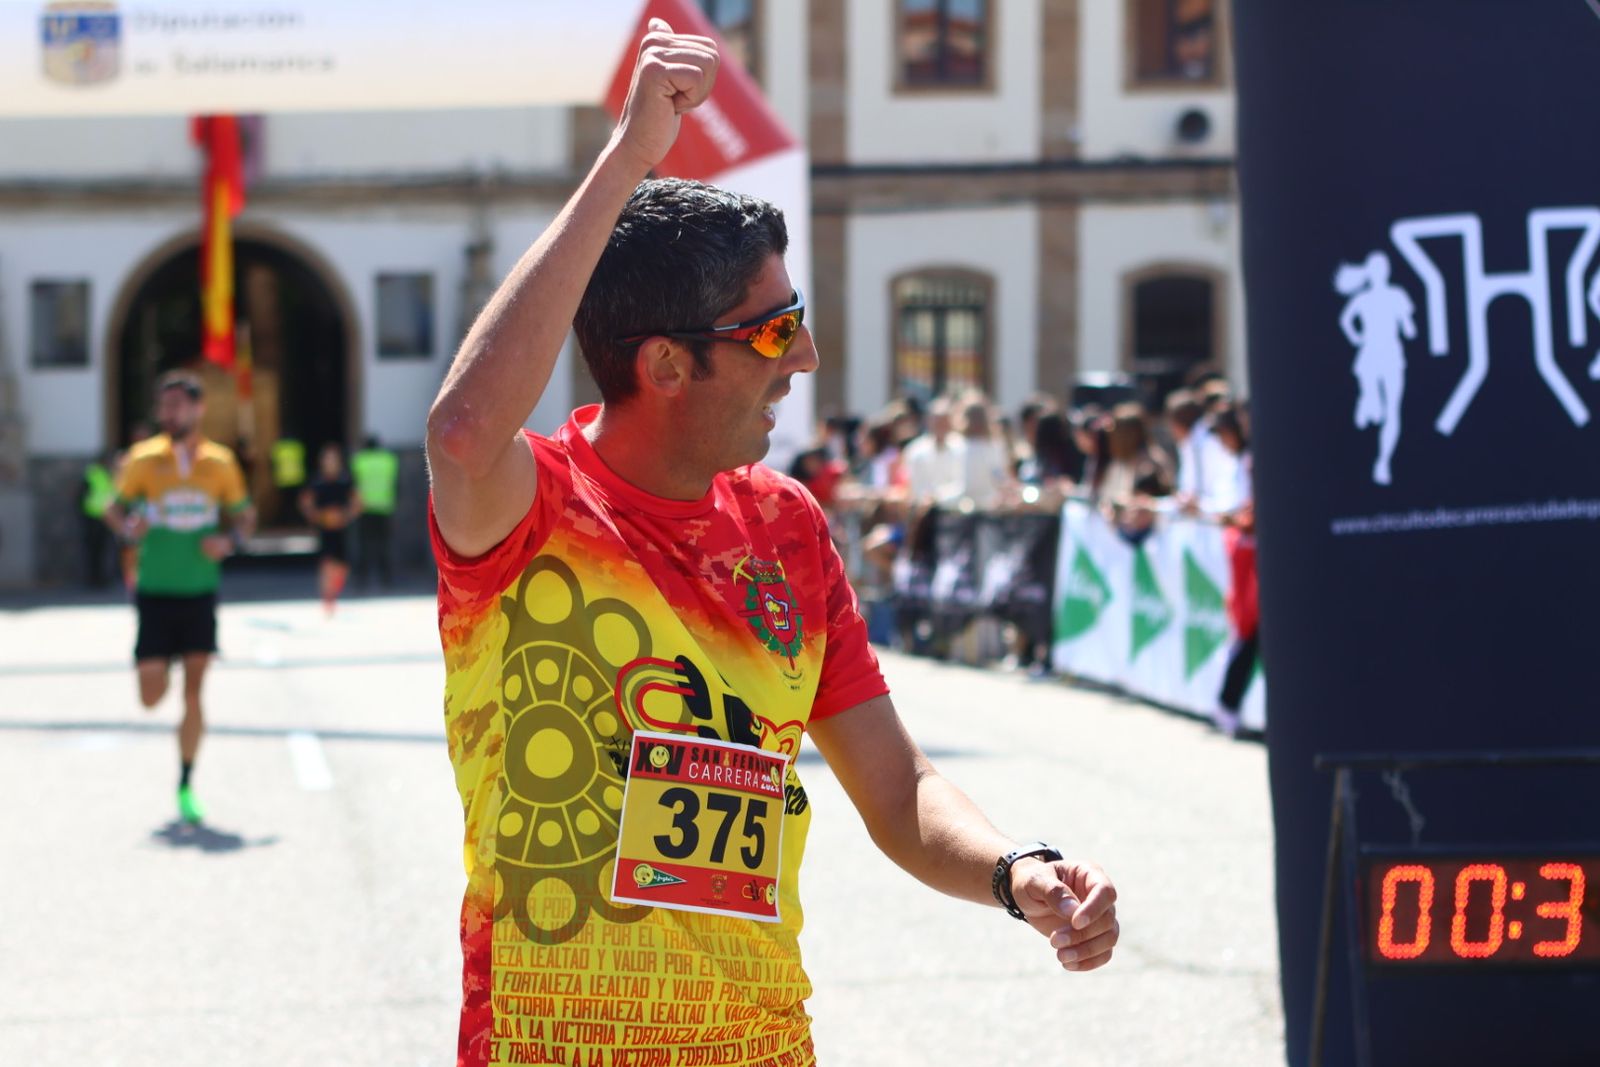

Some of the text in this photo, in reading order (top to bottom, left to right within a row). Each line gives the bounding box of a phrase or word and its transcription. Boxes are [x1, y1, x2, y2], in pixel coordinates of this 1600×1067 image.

[690, 747, 720, 765] SAN
[689, 762, 759, 789] CARRERA
[653, 787, 767, 870] 375
[602, 923, 631, 947] POR
[638, 925, 655, 948] EL
[718, 935, 727, 956] A
[729, 935, 743, 957] LA
[530, 946, 590, 970] LEALTAD
[597, 948, 606, 971] Y
[613, 950, 657, 973] VALOR
[664, 951, 693, 976] POR
[700, 955, 716, 977] EL
[715, 958, 761, 982] TRABAJO
[774, 961, 783, 984] LA
[502, 971, 582, 996] FORTALEZA
[589, 974, 650, 999] LEALTAD
[657, 978, 666, 1000] Y
[673, 979, 715, 1002] VALOR
[719, 981, 744, 1003] POR
[493, 994, 556, 1018] VICTORIA
[561, 997, 644, 1023] FORTALEZA
[650, 1002, 707, 1025] LEALTAD
[711, 1003, 720, 1025] Y
[725, 1004, 761, 1023] VALOR
[515, 1018, 523, 1039] A
[528, 1019, 545, 1041] LA
[552, 1020, 616, 1046] VICTORIA
[621, 1024, 699, 1046] FORTALEZA
[700, 1022, 750, 1043] LEALTAD
[489, 1041, 501, 1063] EL
[508, 1041, 566, 1066] TRABAJO
[572, 1046, 582, 1067] A
[588, 1047, 604, 1067] LA
[611, 1047, 672, 1067] VICTORIA
[676, 1042, 743, 1067] FORTALEZA
[746, 1032, 780, 1060] LEALTAD
